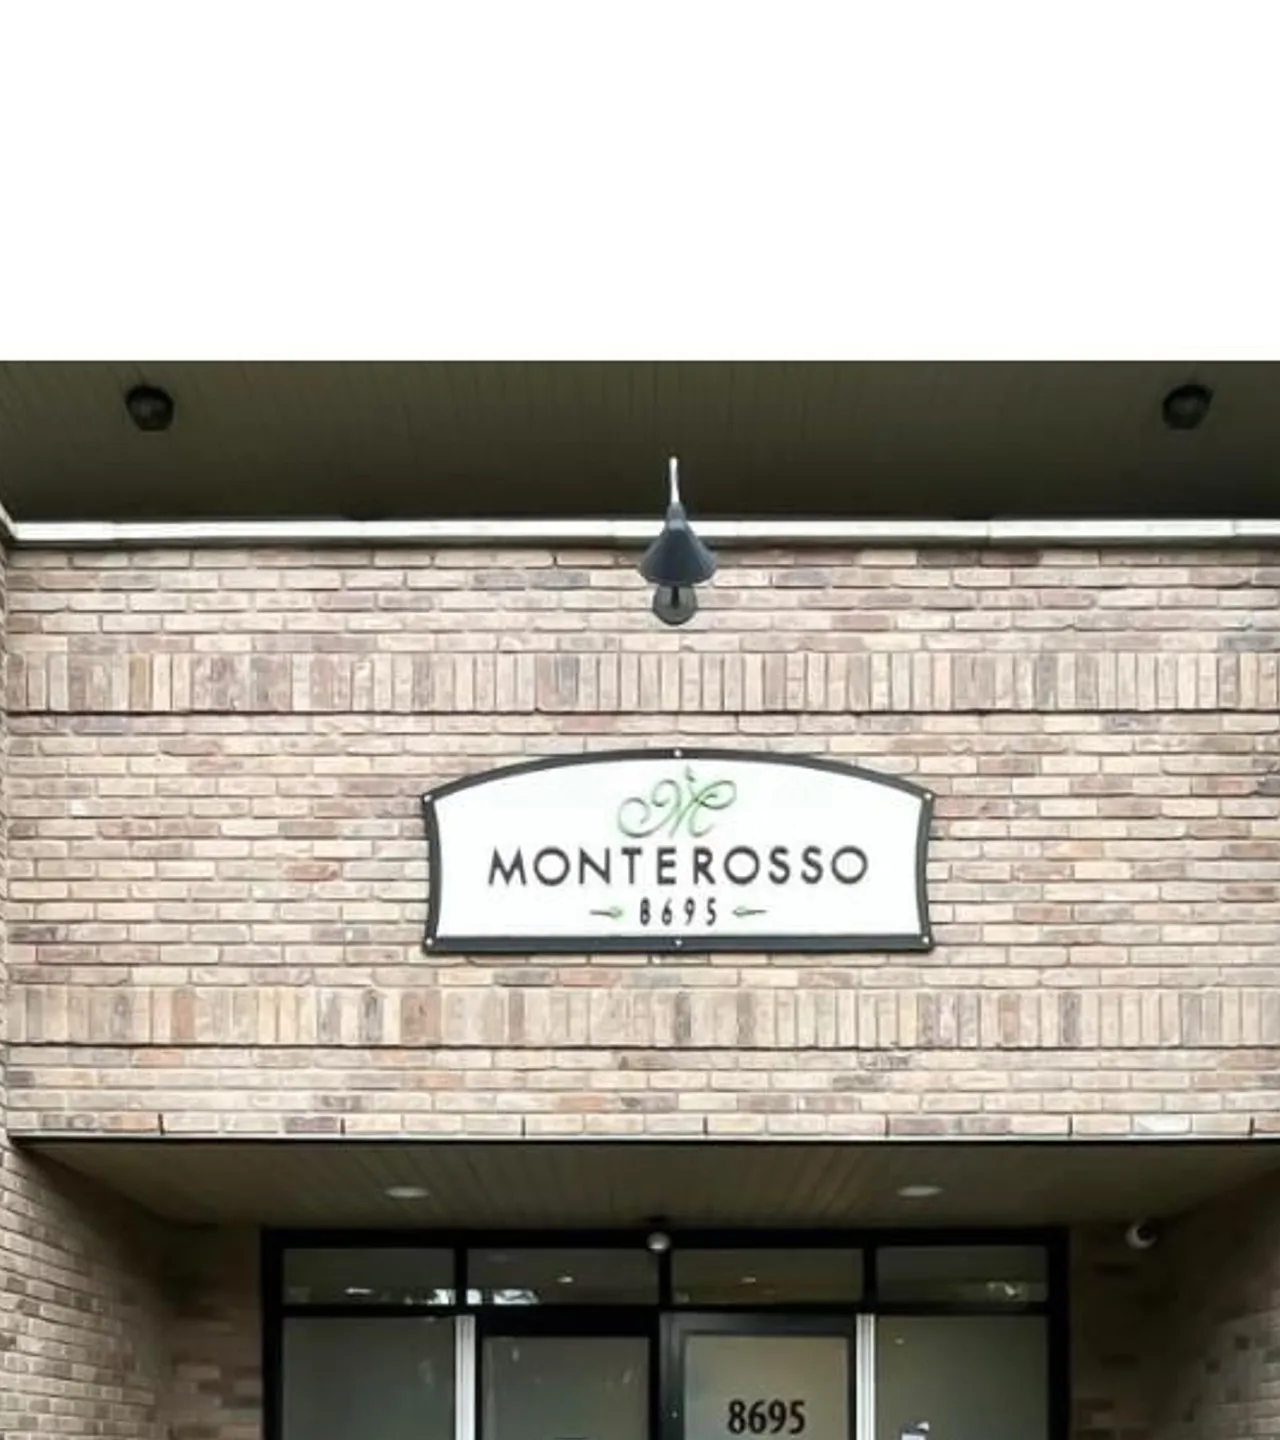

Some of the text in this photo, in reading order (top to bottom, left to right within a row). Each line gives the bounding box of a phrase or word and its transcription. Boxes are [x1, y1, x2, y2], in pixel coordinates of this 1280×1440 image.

[487, 846, 869, 886] MONTEROSSO
[638, 897, 718, 926] 8695
[727, 1398, 806, 1435] 8695
